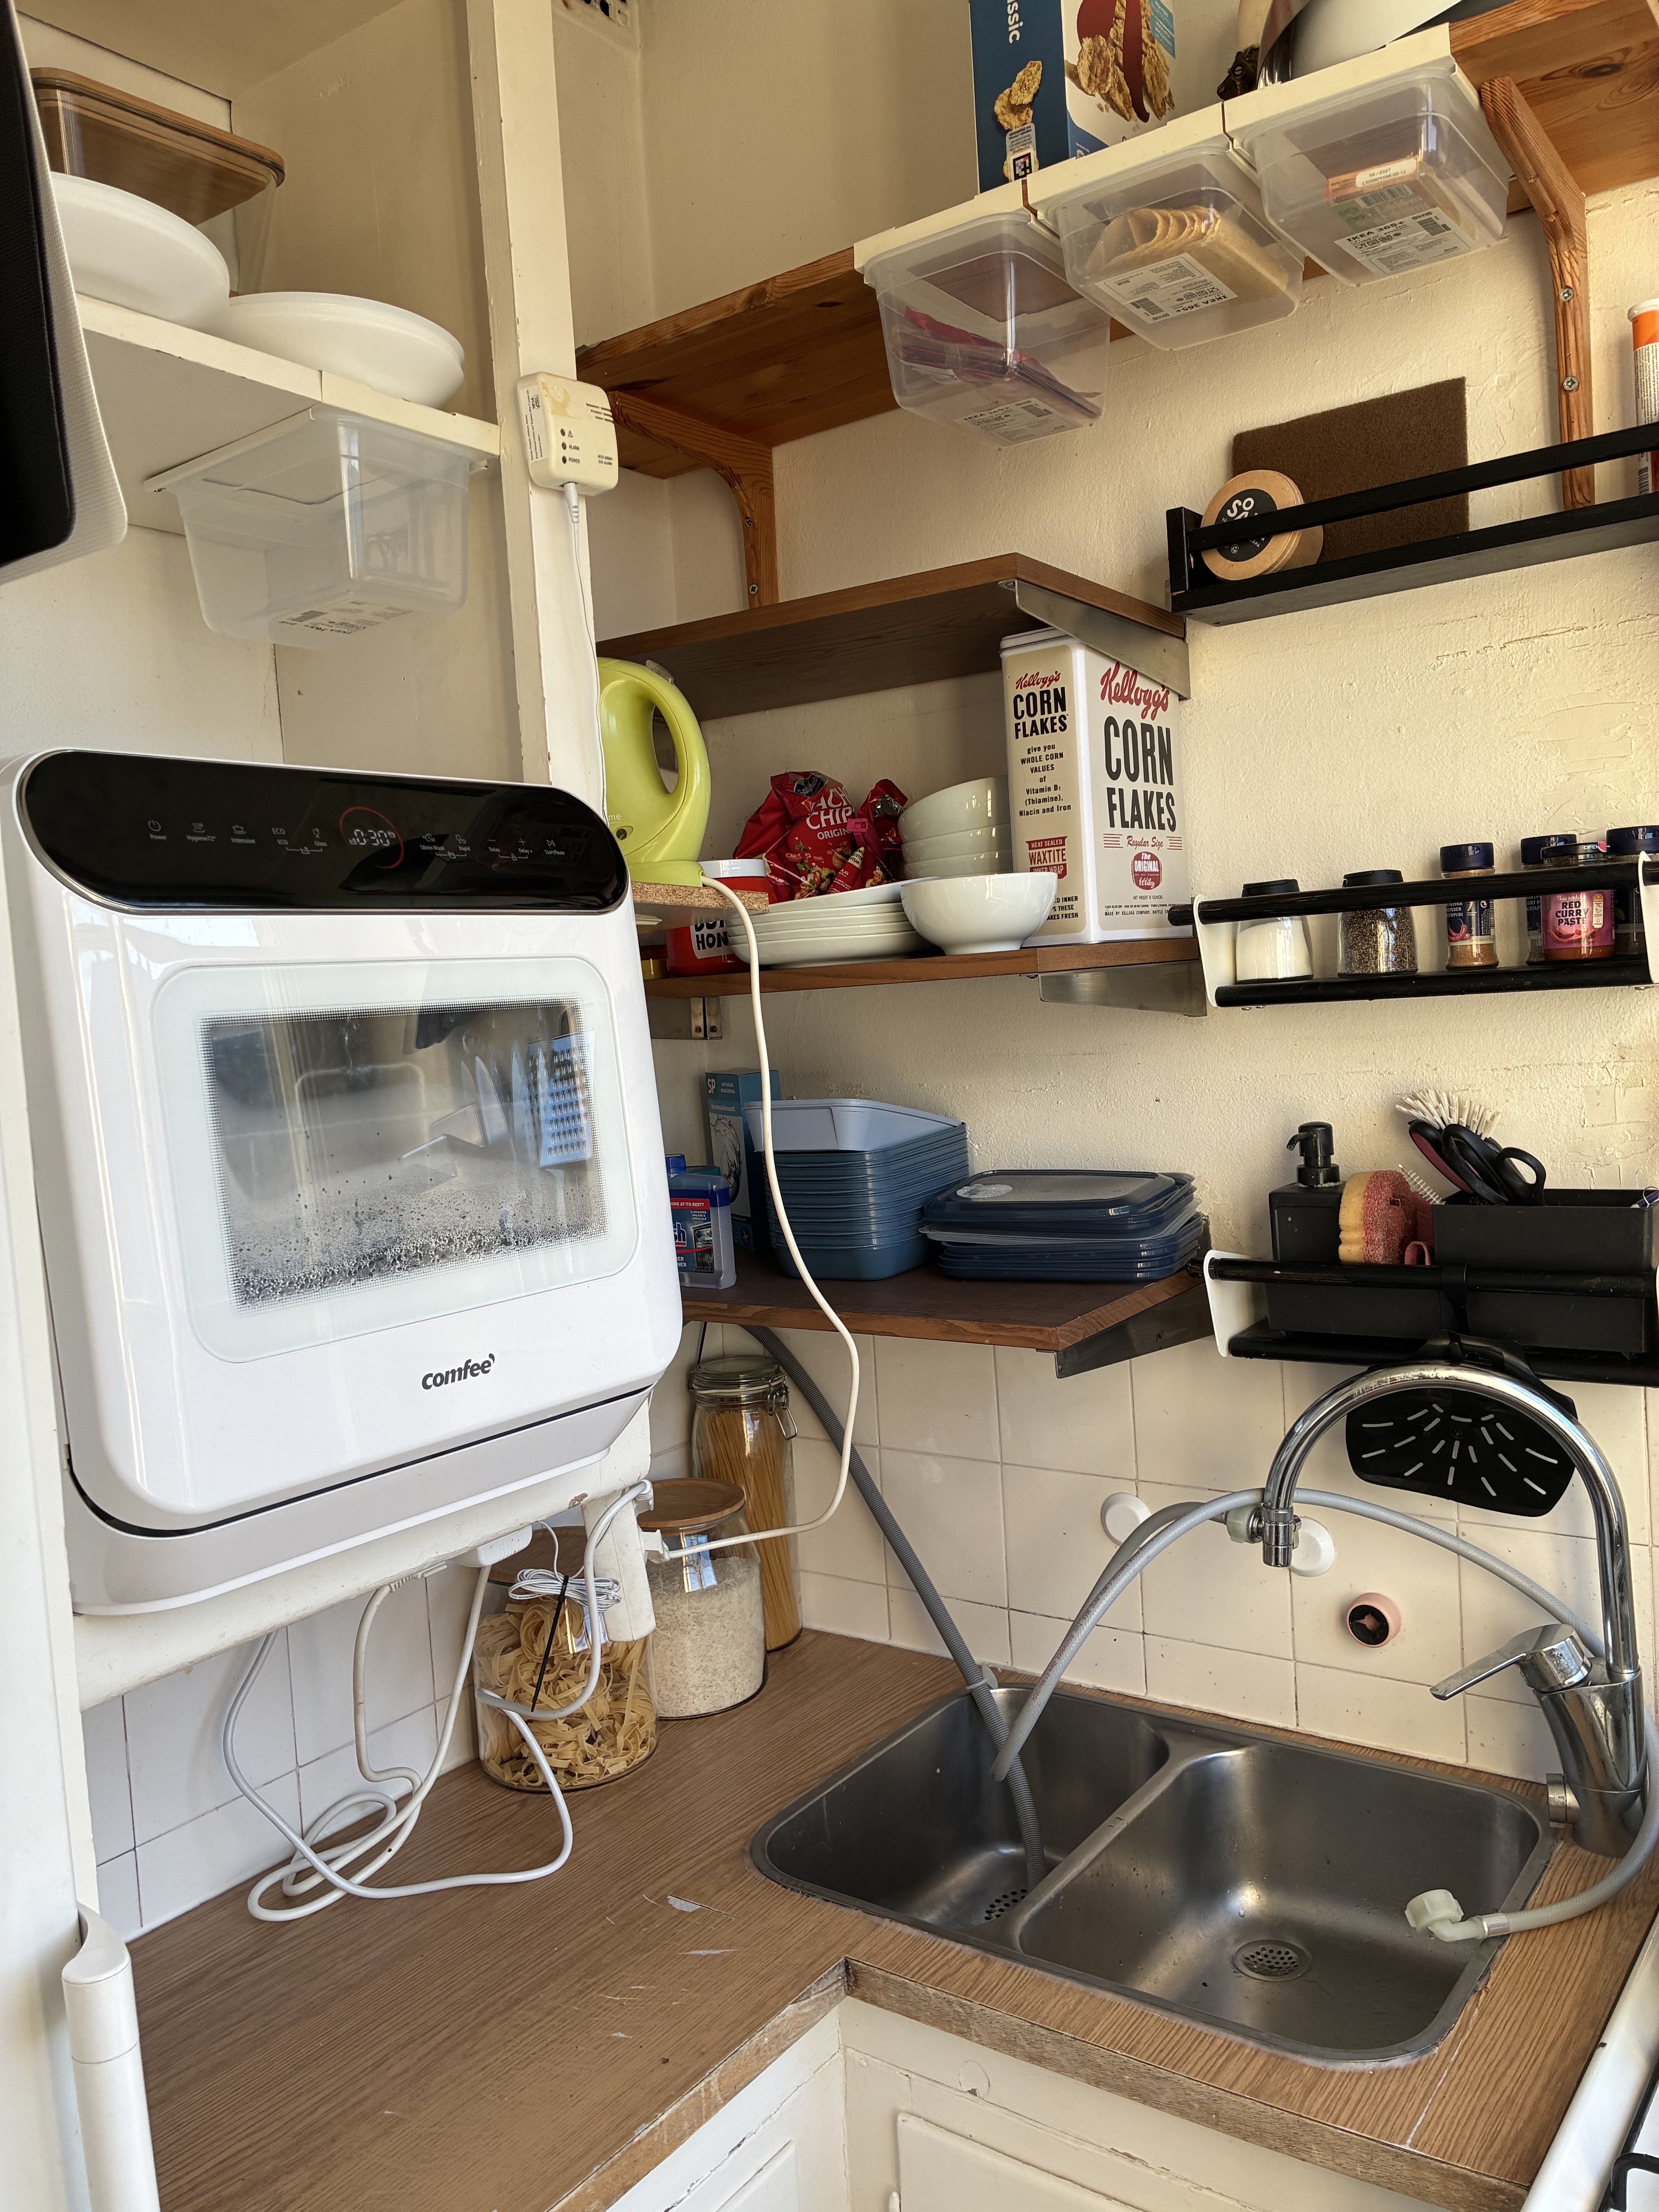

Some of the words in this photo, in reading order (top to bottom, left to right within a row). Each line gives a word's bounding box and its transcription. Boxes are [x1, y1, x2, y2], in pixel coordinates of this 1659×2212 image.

[1007, 0, 1024, 44] ssic
[1346, 231, 1374, 242] IKEA
[1200, 295, 1228, 305] IKEA
[1226, 497, 1255, 517] SO
[1015, 670, 1061, 690] Kellogg's
[1100, 661, 1170, 721] Kellogg's
[1013, 687, 1067, 720] CORN
[1014, 714, 1068, 739] FLAKES
[1027, 746, 1041, 755] give
[1043, 744, 1055, 752] you
[1104, 715, 1174, 786] CORN
[1020, 755, 1043, 765] WHOLE
[1045, 752, 1064, 761] CORN
[1030, 764, 1054, 774] VALUES
[1026, 786, 1051, 795] Vitamin
[1025, 794, 1063, 806] (Thiamine),
[1019, 808, 1040, 817] Niacin
[1042, 805, 1054, 814] and
[1106, 787, 1176, 832] FLAKES
[806, 805, 854, 830] CHIP
[354, 829, 390, 846] 0:30
[817, 828, 851, 840] ORIGIN
[1044, 839, 1063, 847] SEALED
[1127, 835, 1149, 850] Regular
[1151, 836, 1164, 851] Size
[850, 857, 860, 865] VEGAN
[1029, 848, 1066, 865] WAXTITE
[1049, 865, 1064, 874] WRAP
[1134, 860, 1159, 872] ORIGINAL
[1562, 901, 1581, 910] RED
[1555, 908, 1589, 918] CURRY
[1558, 917, 1587, 926] PASTE
[696, 931, 731, 950] HON
[708, 1078, 716, 1094] SP
